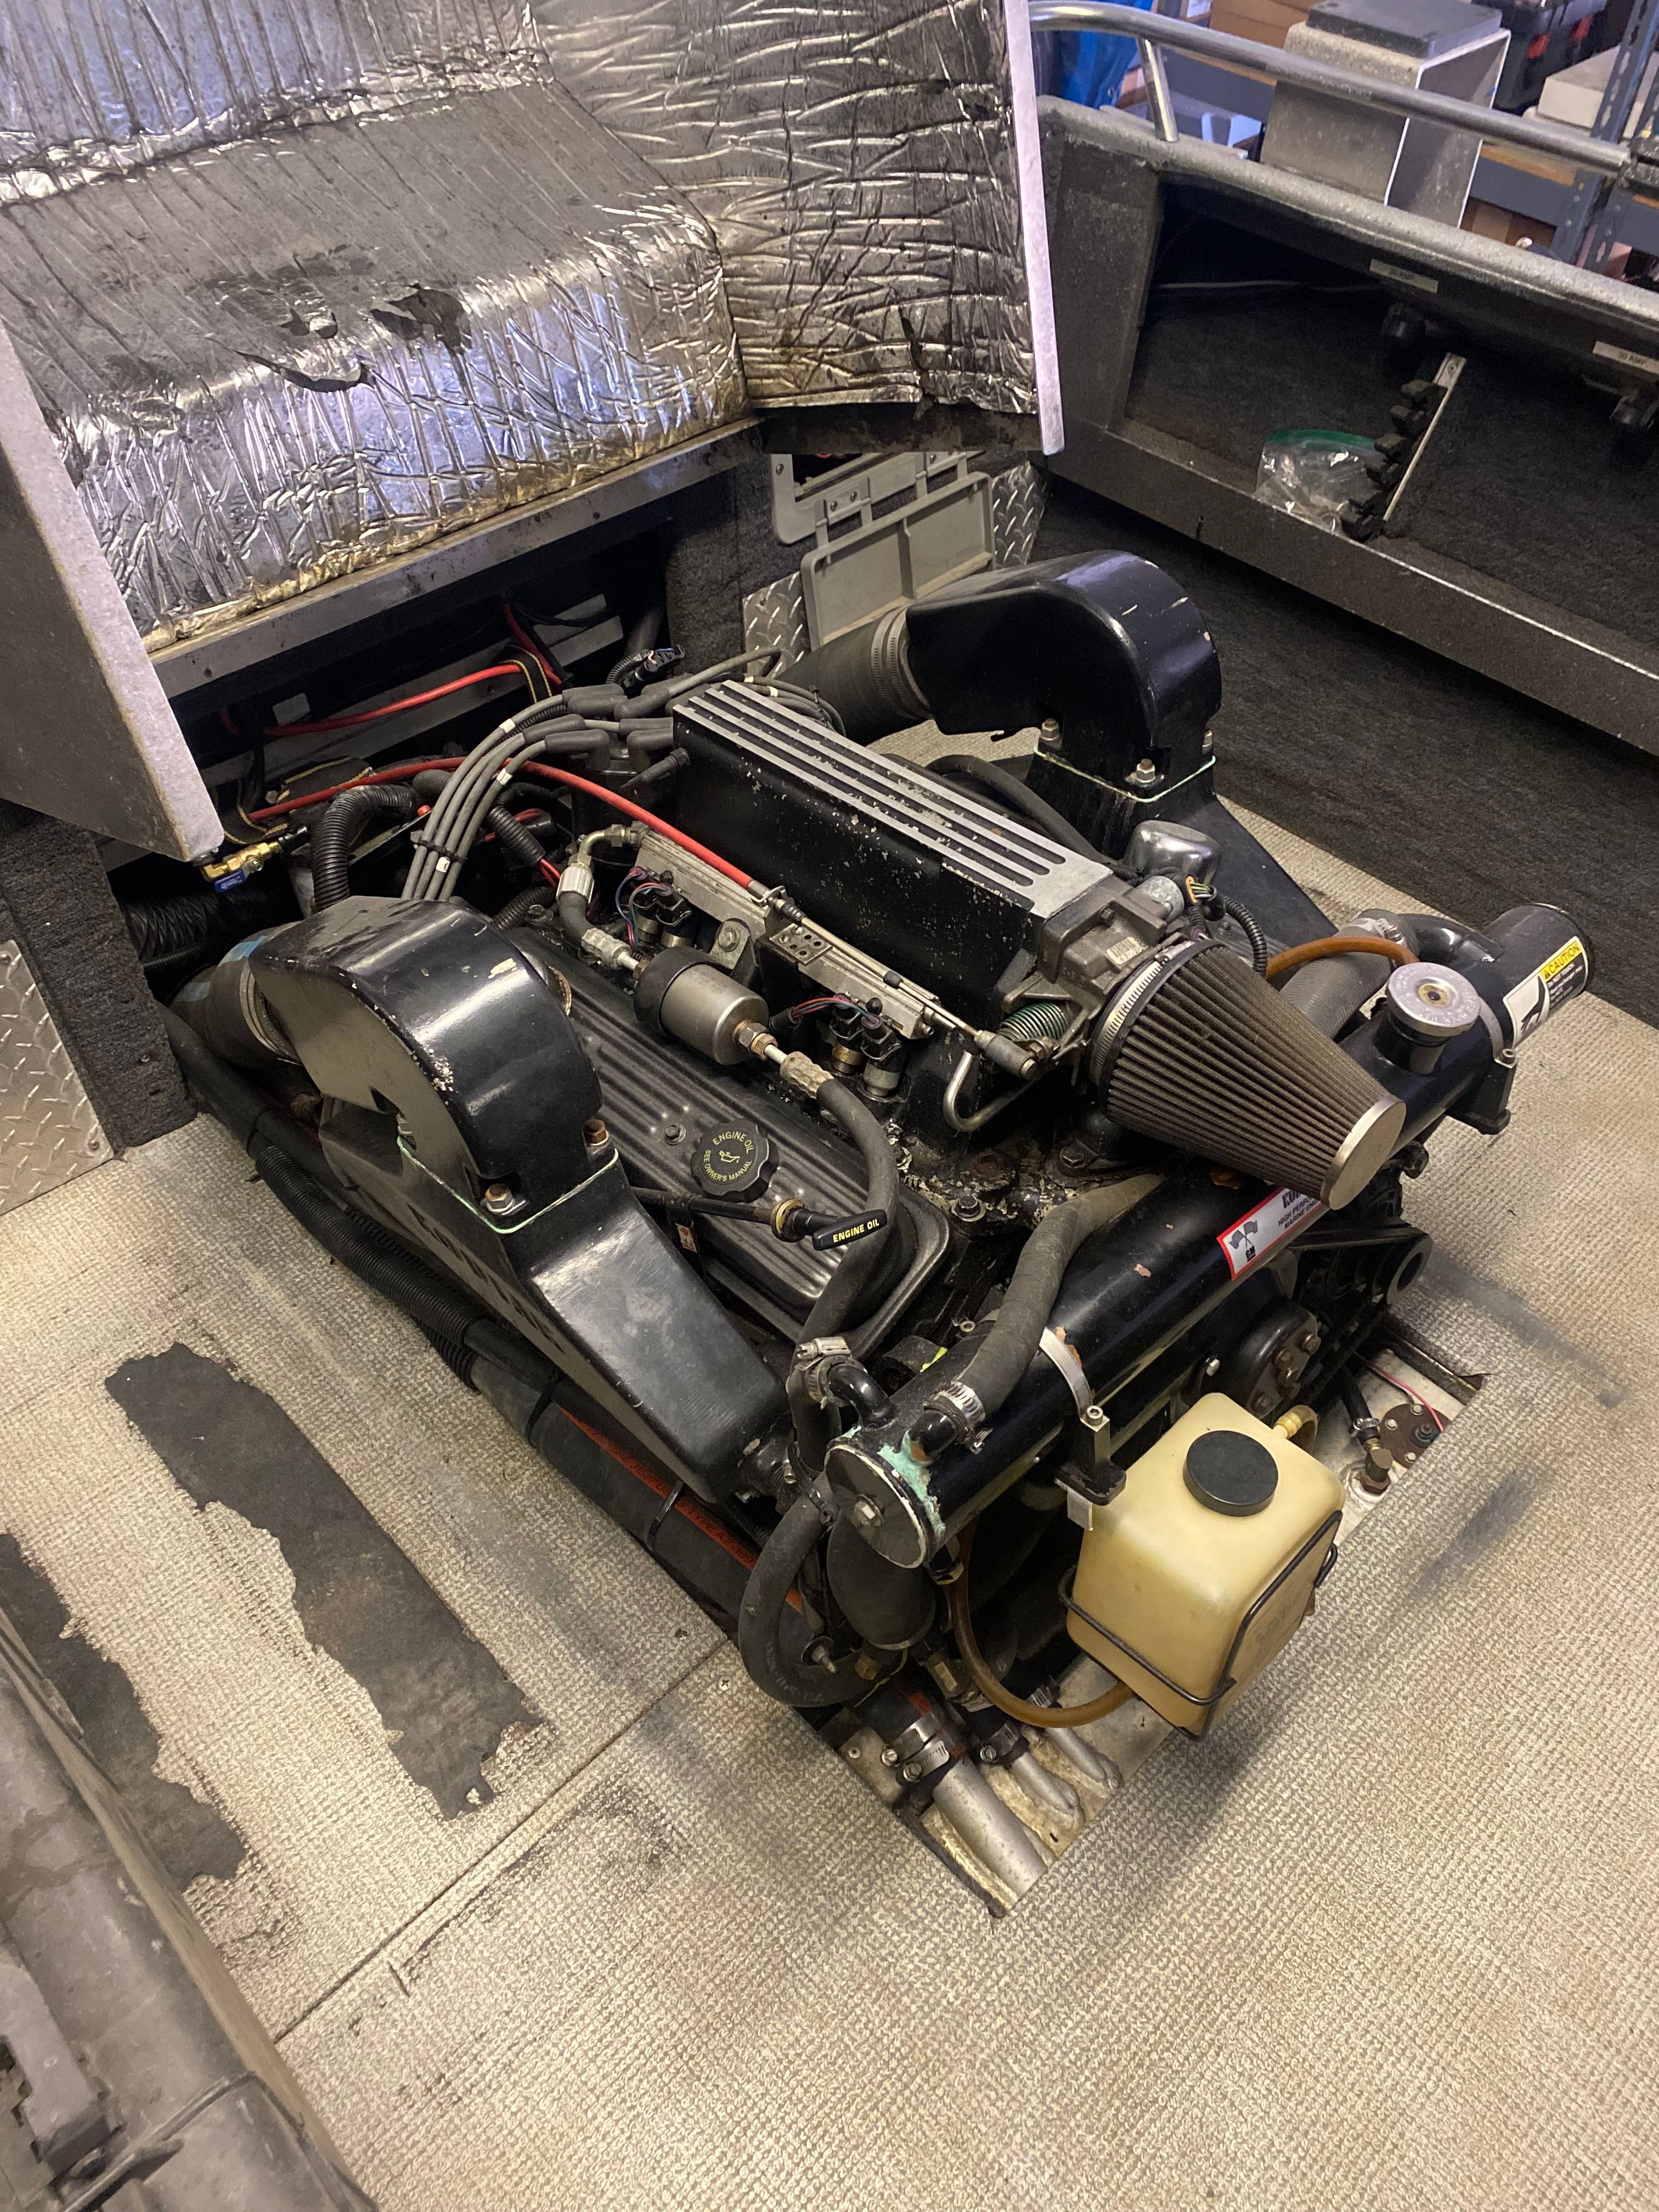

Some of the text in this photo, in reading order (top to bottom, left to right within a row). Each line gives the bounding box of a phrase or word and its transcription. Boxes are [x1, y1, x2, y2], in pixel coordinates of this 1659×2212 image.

[1549, 944, 1579, 974] CAUTION
[713, 1131, 754, 1154] ENGINE OIL
[704, 1164, 727, 1181] OWNER'S
[729, 1160, 752, 1181] MANUAL
[1278, 1211, 1291, 1227] HIGH
[1284, 1208, 1305, 1229] MARINE
[833, 1218, 879, 1243] ENGINE OIL
[1246, 1245, 1255, 1259] GM
